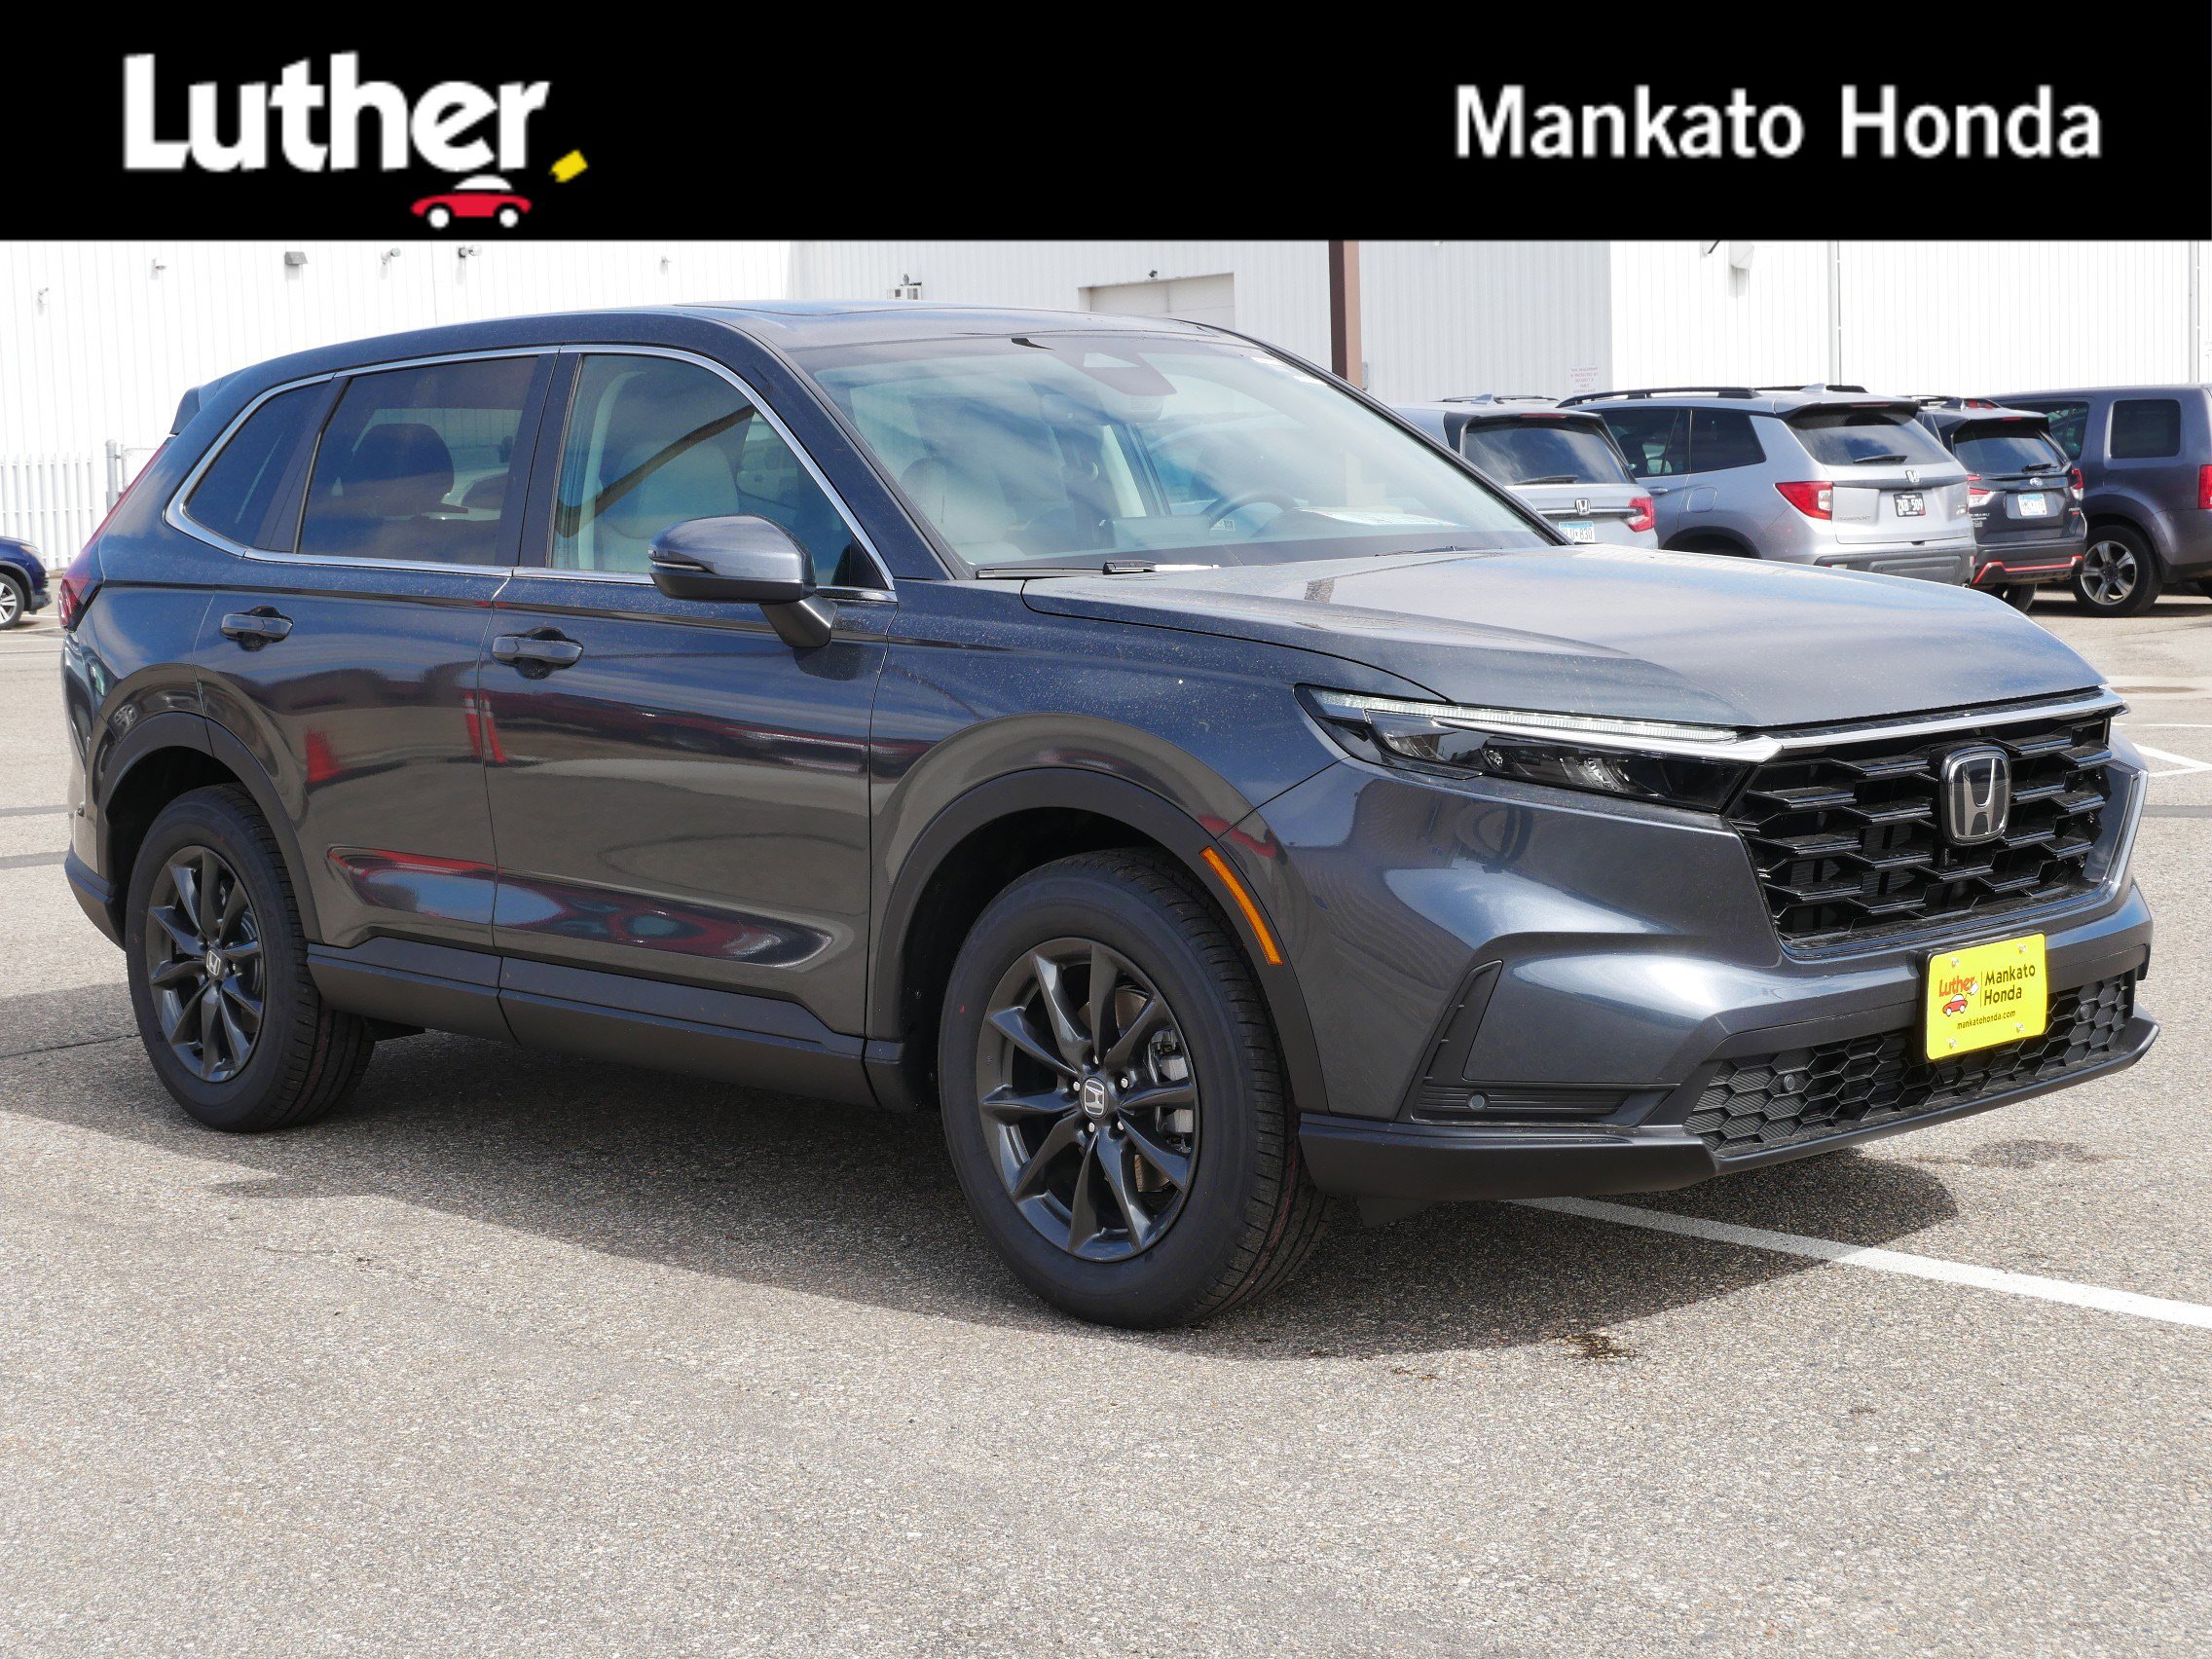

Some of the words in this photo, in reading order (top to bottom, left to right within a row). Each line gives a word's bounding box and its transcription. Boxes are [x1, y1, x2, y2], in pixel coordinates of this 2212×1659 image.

[1984, 963, 2036, 986] Mankato
[1938, 975, 1975, 997] Luther
[1983, 984, 2022, 1007] Honda
[1956, 1010, 2016, 1030] mankatohonda.com
